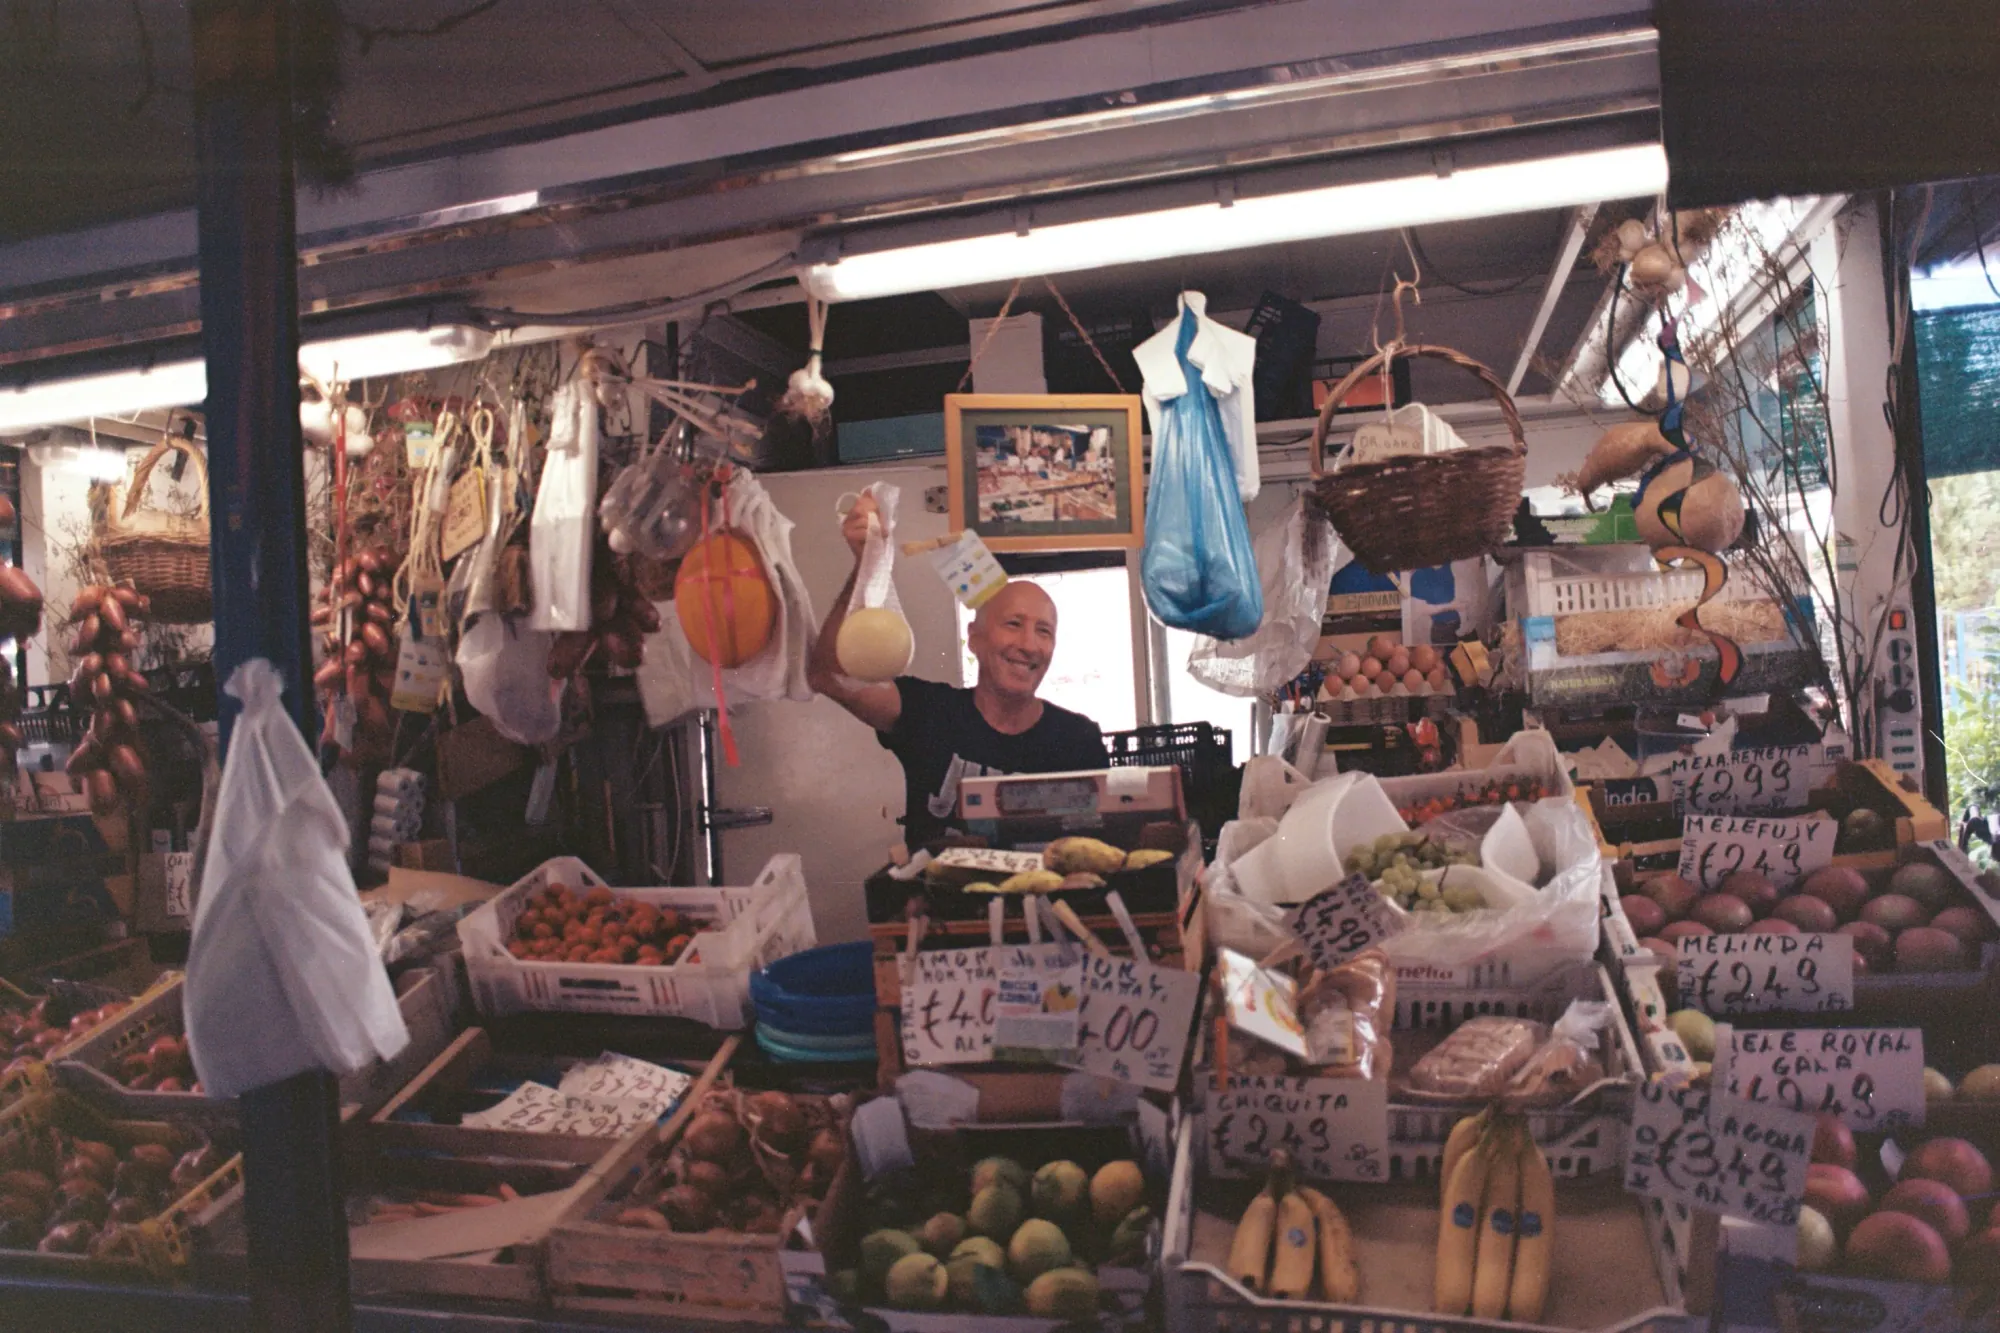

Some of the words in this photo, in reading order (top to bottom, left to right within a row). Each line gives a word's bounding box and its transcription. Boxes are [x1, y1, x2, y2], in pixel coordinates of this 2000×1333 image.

[1683, 934, 1824, 955] MELINDA
[1821, 1032, 1911, 1056] ROYAL
[1771, 1055, 1852, 1076] GALA
[1217, 1094, 1349, 1114] CHIQUITA
